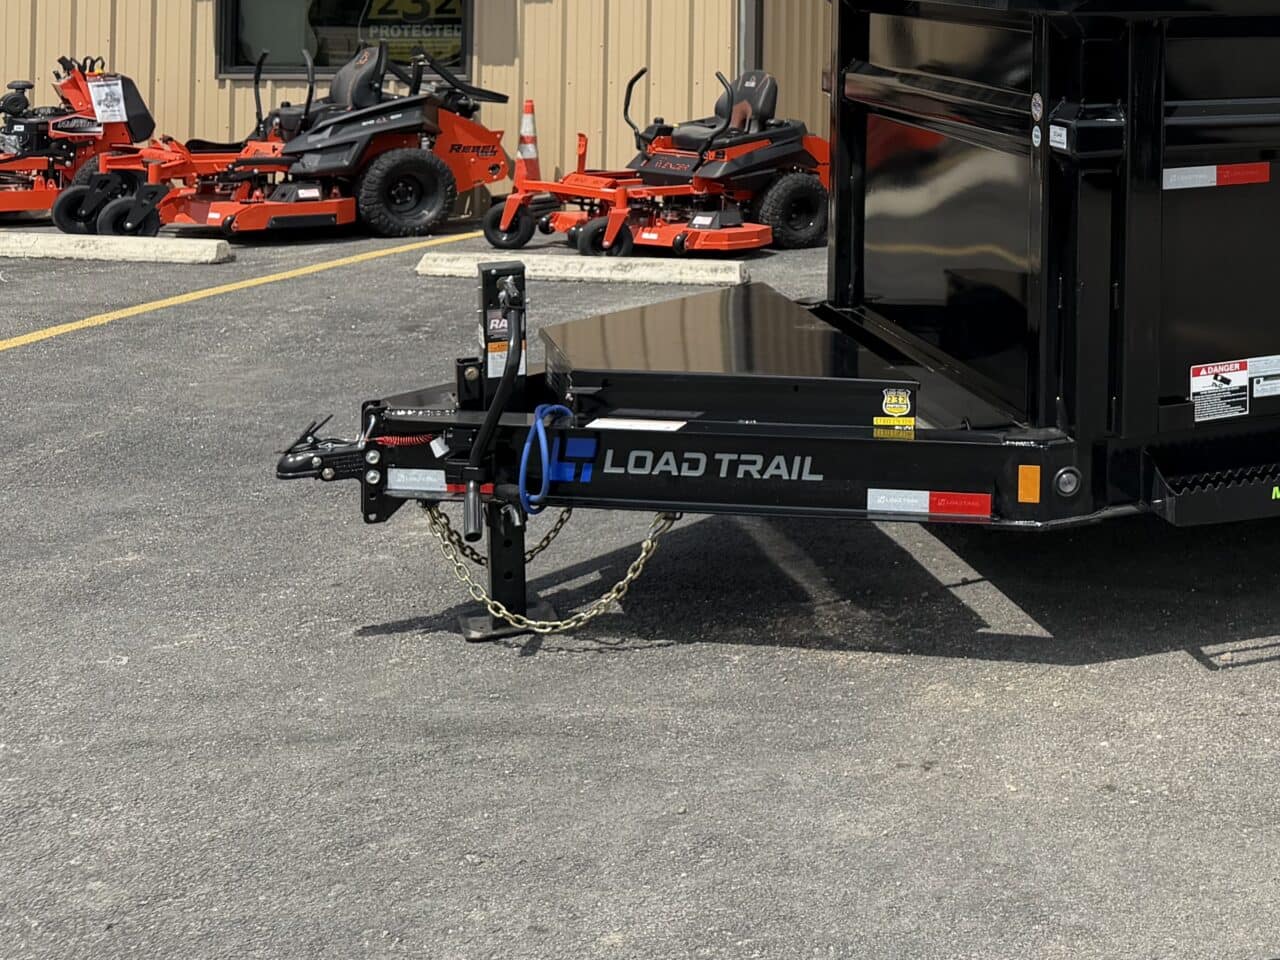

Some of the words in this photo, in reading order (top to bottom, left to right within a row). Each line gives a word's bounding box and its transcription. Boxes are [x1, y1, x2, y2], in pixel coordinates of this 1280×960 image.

[489, 319, 508, 330] RA
[1207, 363, 1240, 374] DANGER
[603, 449, 708, 476] LOAD
[714, 453, 824, 481] TRAIL
